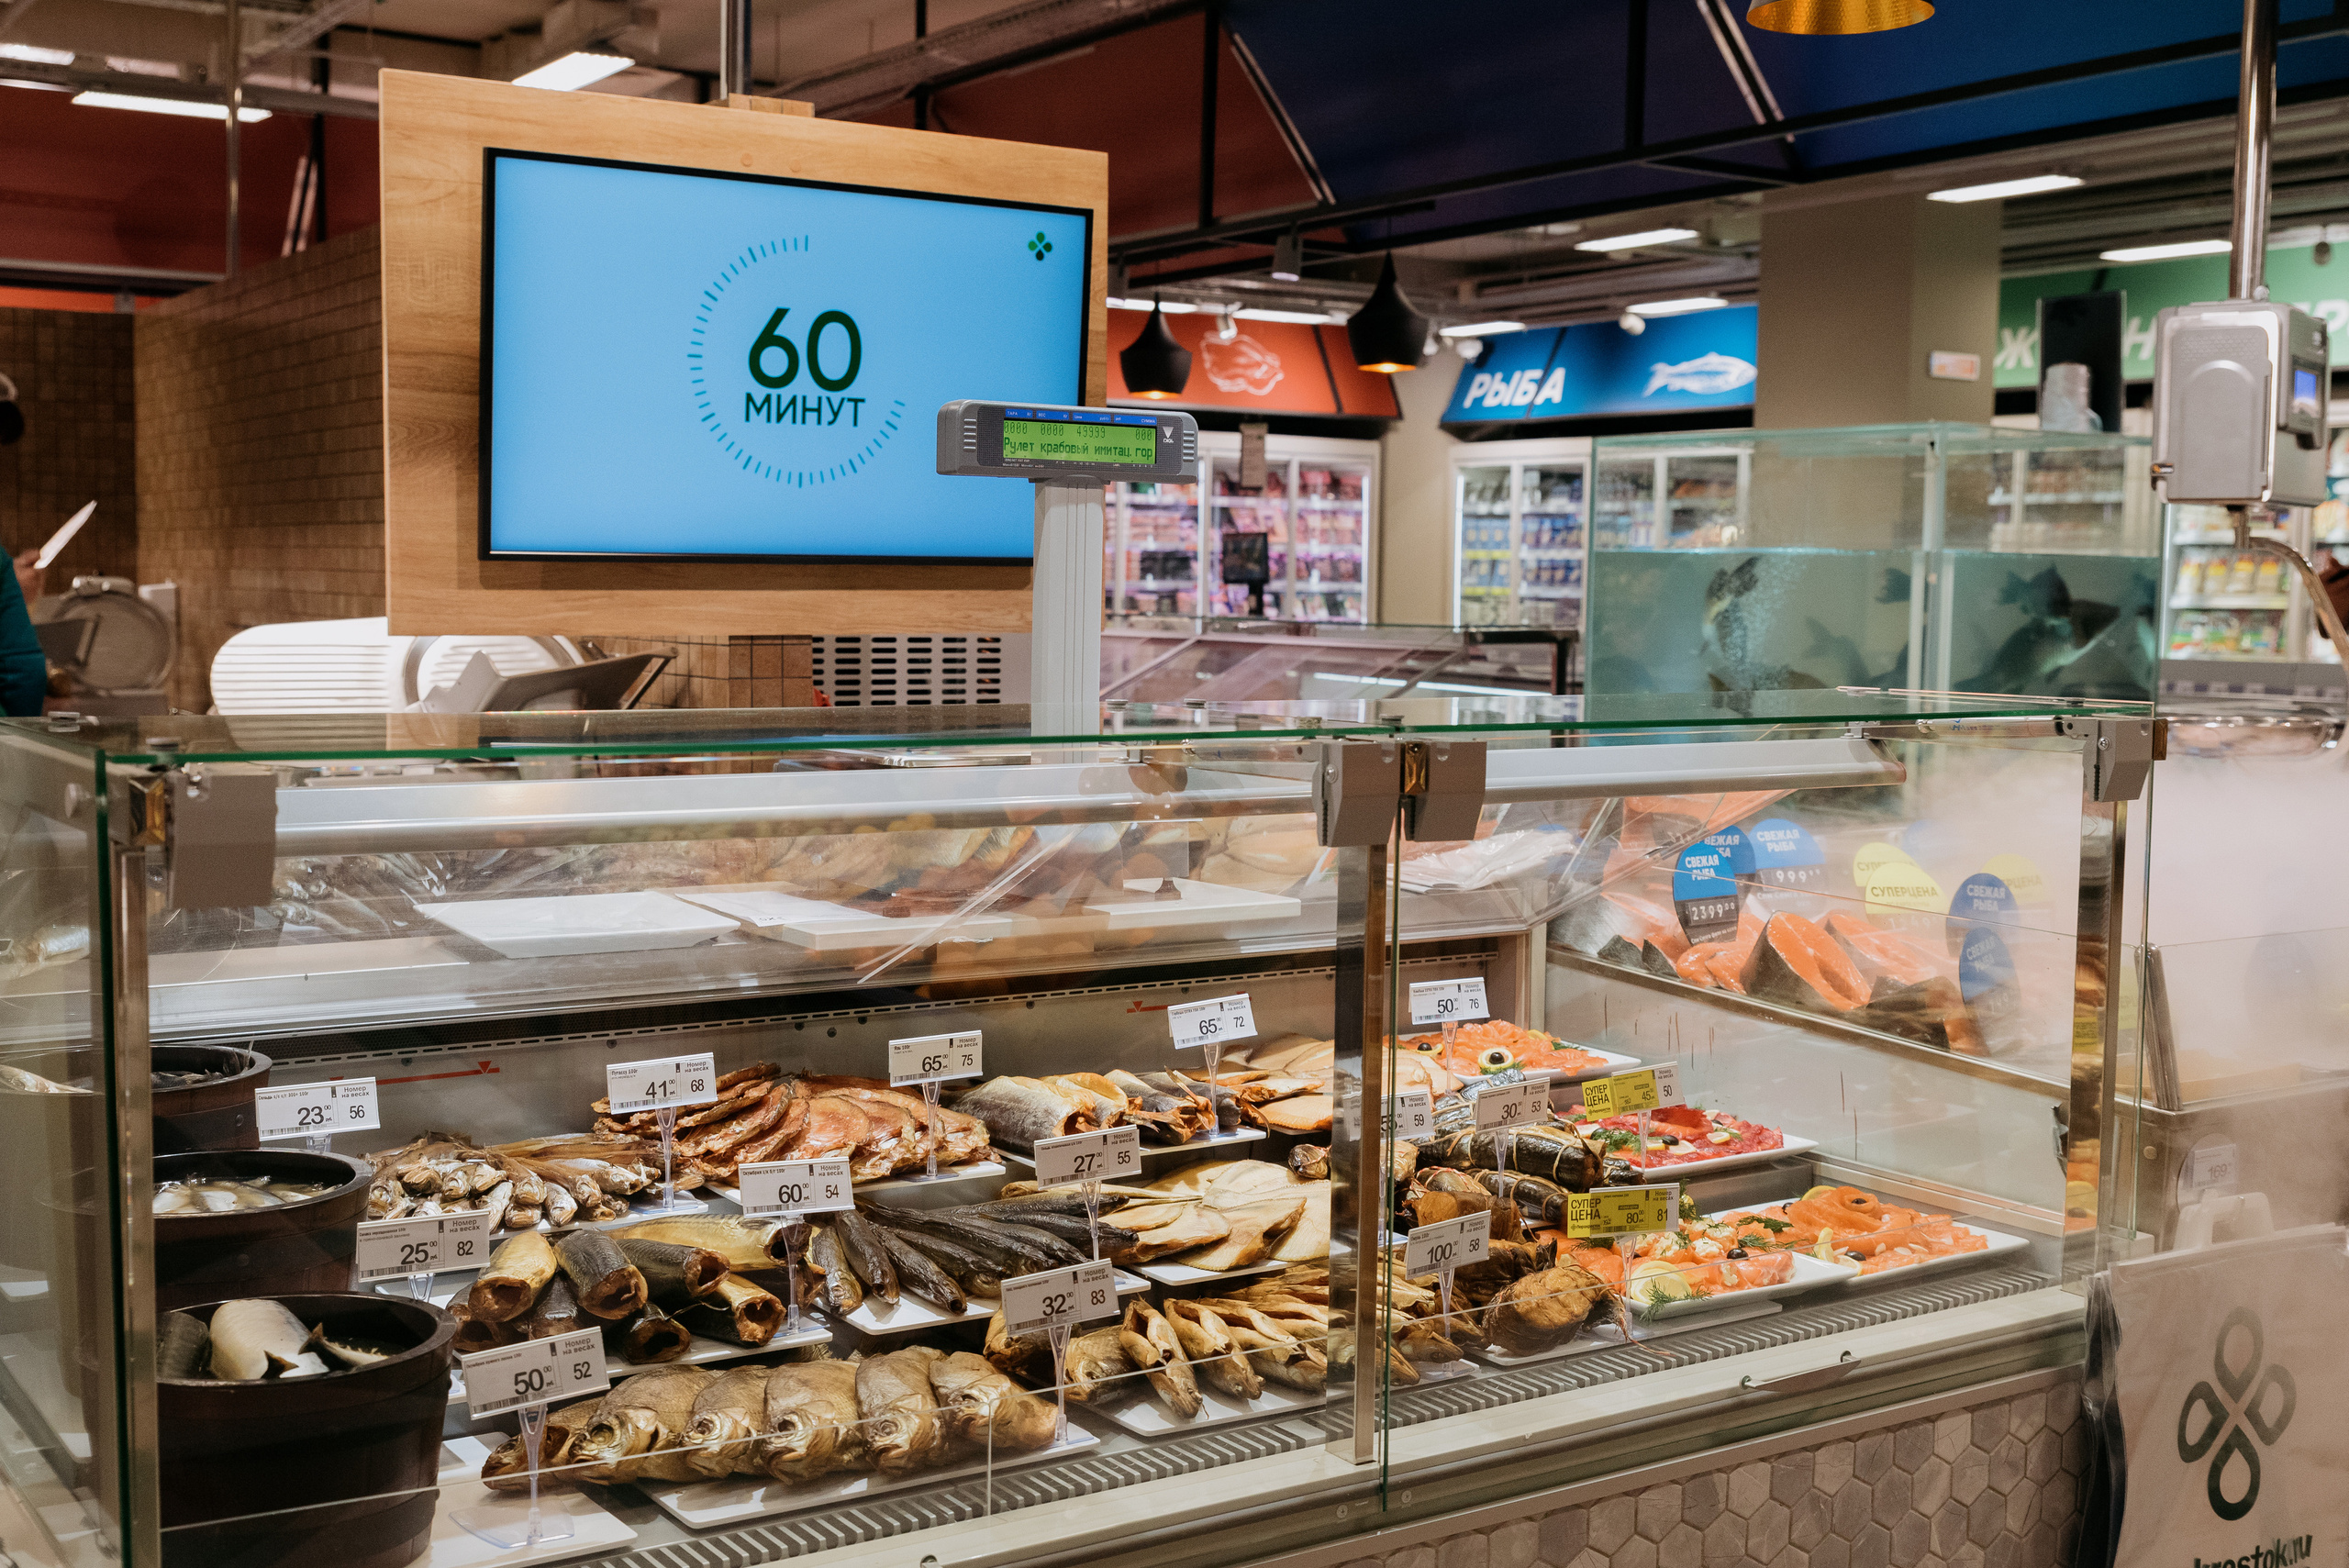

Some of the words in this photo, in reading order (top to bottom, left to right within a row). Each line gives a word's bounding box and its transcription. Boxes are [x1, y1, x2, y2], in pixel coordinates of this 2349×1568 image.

[748, 306, 862, 392] 60
[1463, 367, 1565, 408] РЫБА
[745, 392, 865, 427] МИНУТ
[1004, 437, 1034, 454] Рулет
[1041, 440, 1088, 455] крабовый
[1094, 445, 1131, 457] имитац.
[1135, 448, 1152, 461] гор
[1756, 828, 1800, 841] СВЕЖАЯ
[1766, 840, 1797, 852] РЫБА
[1685, 854, 1720, 868] СВЕЖАЯ
[1692, 868, 1716, 881] РЫБА
[1871, 886, 1939, 898] СУПЕРЦЕНА
[1966, 884, 2006, 899] СВЕЖАЯ
[1691, 904, 1723, 920] 2399
[1973, 899, 1999, 912] РЫБА
[1438, 999, 1453, 1013] 50
[1469, 998, 1479, 1008] 76
[1199, 1018, 1217, 1035] 65
[1233, 1017, 1244, 1028] 72
[922, 1055, 941, 1072] 65
[962, 1054, 973, 1066] 75
[646, 1080, 667, 1098] 41
[691, 1079, 704, 1092] 68
[1586, 1084, 1608, 1095] СУПЕР
[1664, 1085, 1672, 1096] 50
[1586, 1094, 1609, 1107] ЦЕНА
[1642, 1091, 1651, 1101] 45
[350, 1105, 365, 1119] 56
[1501, 1103, 1517, 1119] 30
[1531, 1101, 1542, 1113] 53
[297, 1106, 324, 1126] 23
[1414, 1114, 1424, 1127] 59
[1074, 1153, 1096, 1173] 27
[1118, 1151, 1130, 1164] 55
[779, 1184, 802, 1203] 60
[826, 1184, 839, 1198] 54
[1571, 1198, 1601, 1208] СУПЕР
[1571, 1209, 1600, 1222] ЦЕНА
[1627, 1212, 1639, 1224] 80
[1657, 1208, 1668, 1221] 81
[457, 1240, 473, 1257] 82
[1469, 1239, 1479, 1252] 58
[400, 1242, 429, 1264] 25
[1428, 1242, 1453, 1263] 100
[1085, 1268, 1105, 1276] Номер
[1091, 1289, 1106, 1306] 83
[1042, 1294, 1066, 1316] 32
[565, 1338, 591, 1348] Номер
[573, 1344, 595, 1352] весах
[573, 1362, 592, 1380] 52
[515, 1369, 544, 1395] 50
